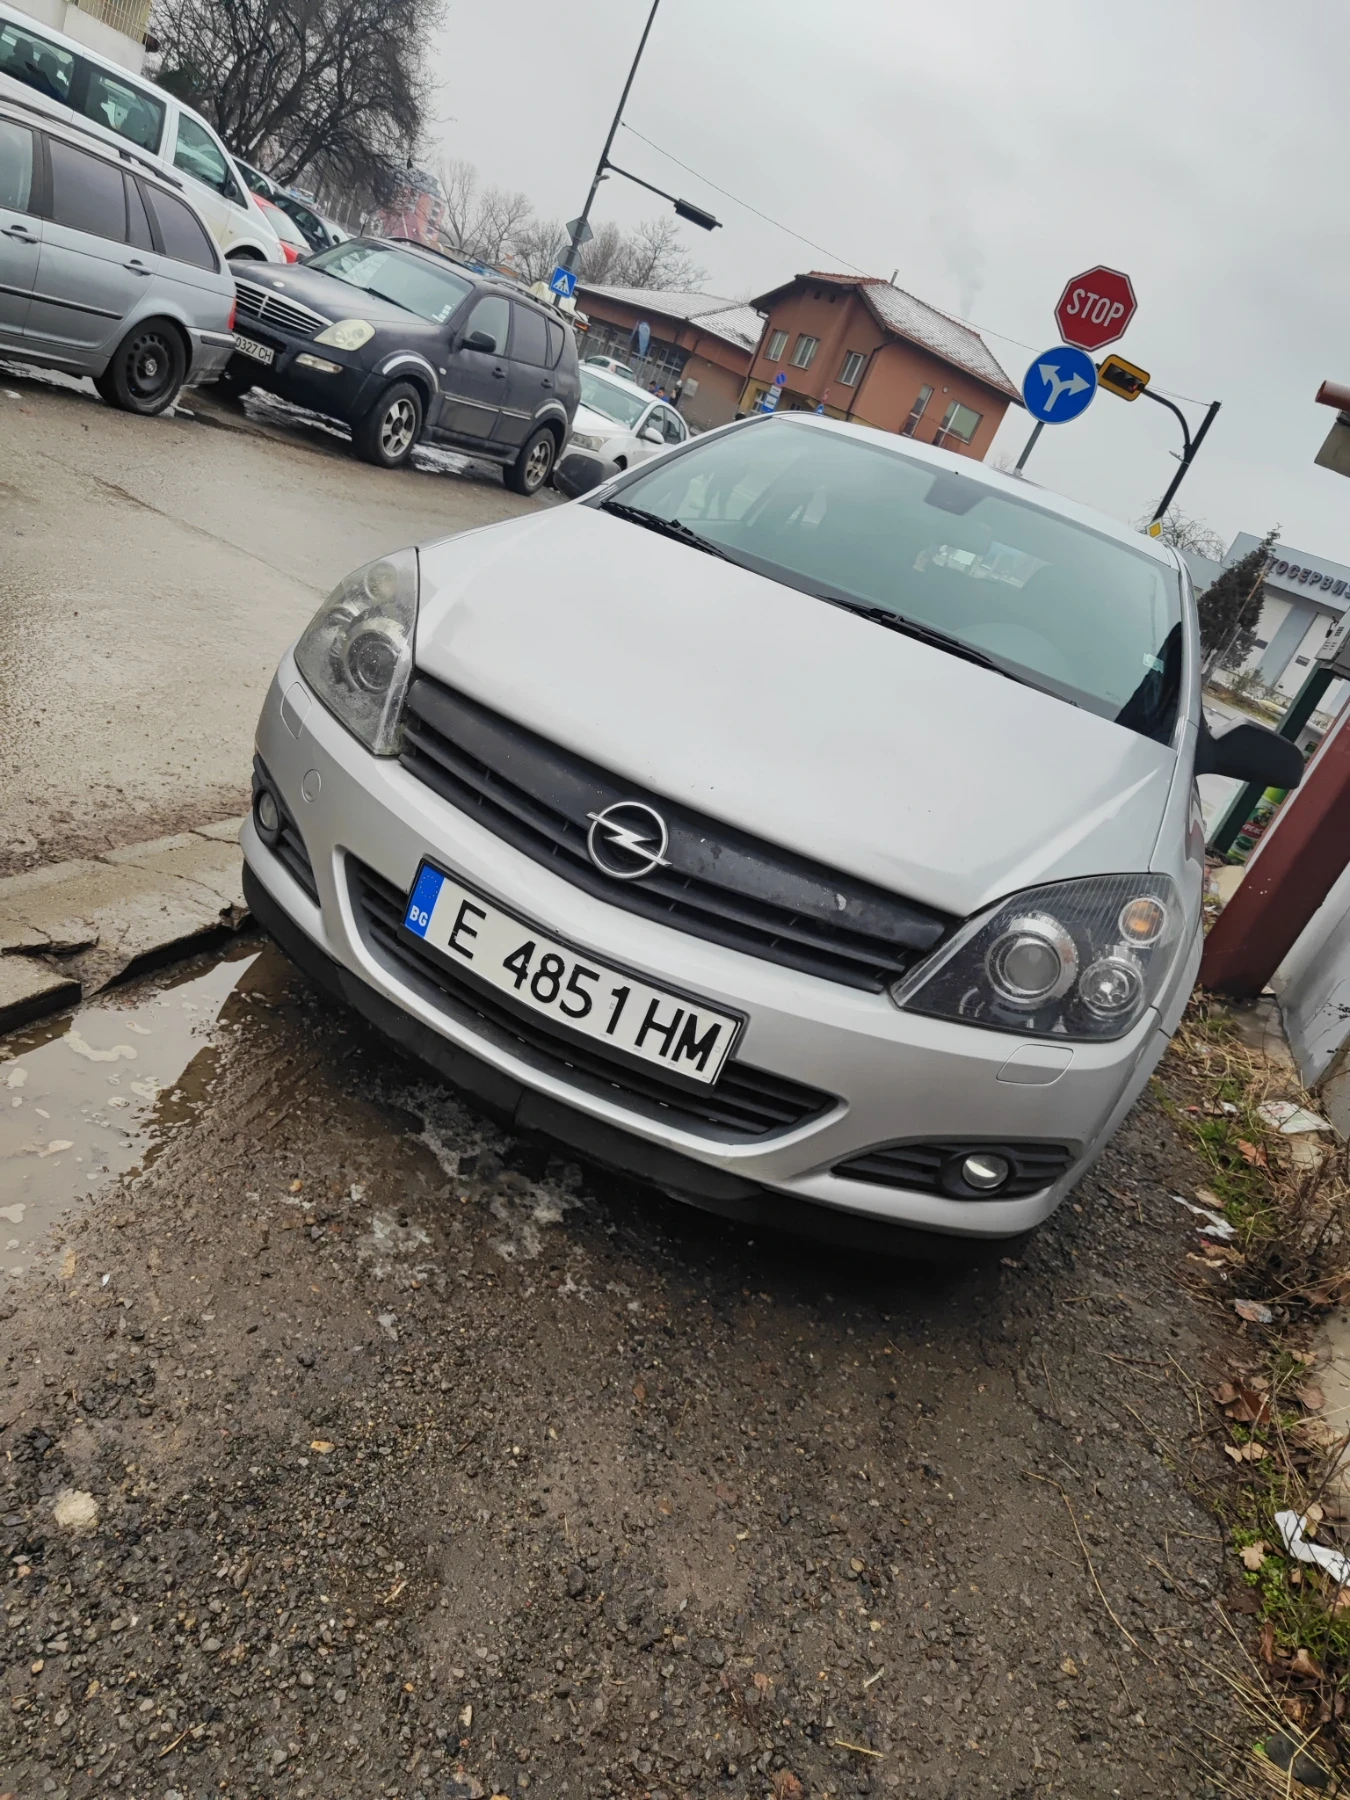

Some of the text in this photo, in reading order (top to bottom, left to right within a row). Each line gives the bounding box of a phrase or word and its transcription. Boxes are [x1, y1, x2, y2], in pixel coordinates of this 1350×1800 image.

[1066, 288, 1125, 327] STOP
[235, 336, 273, 362] 0327 CH
[1259, 552, 1350, 599] ТОСЕРВИ
[409, 904, 428, 927] BG
[447, 899, 722, 1073] E 4851 HM
